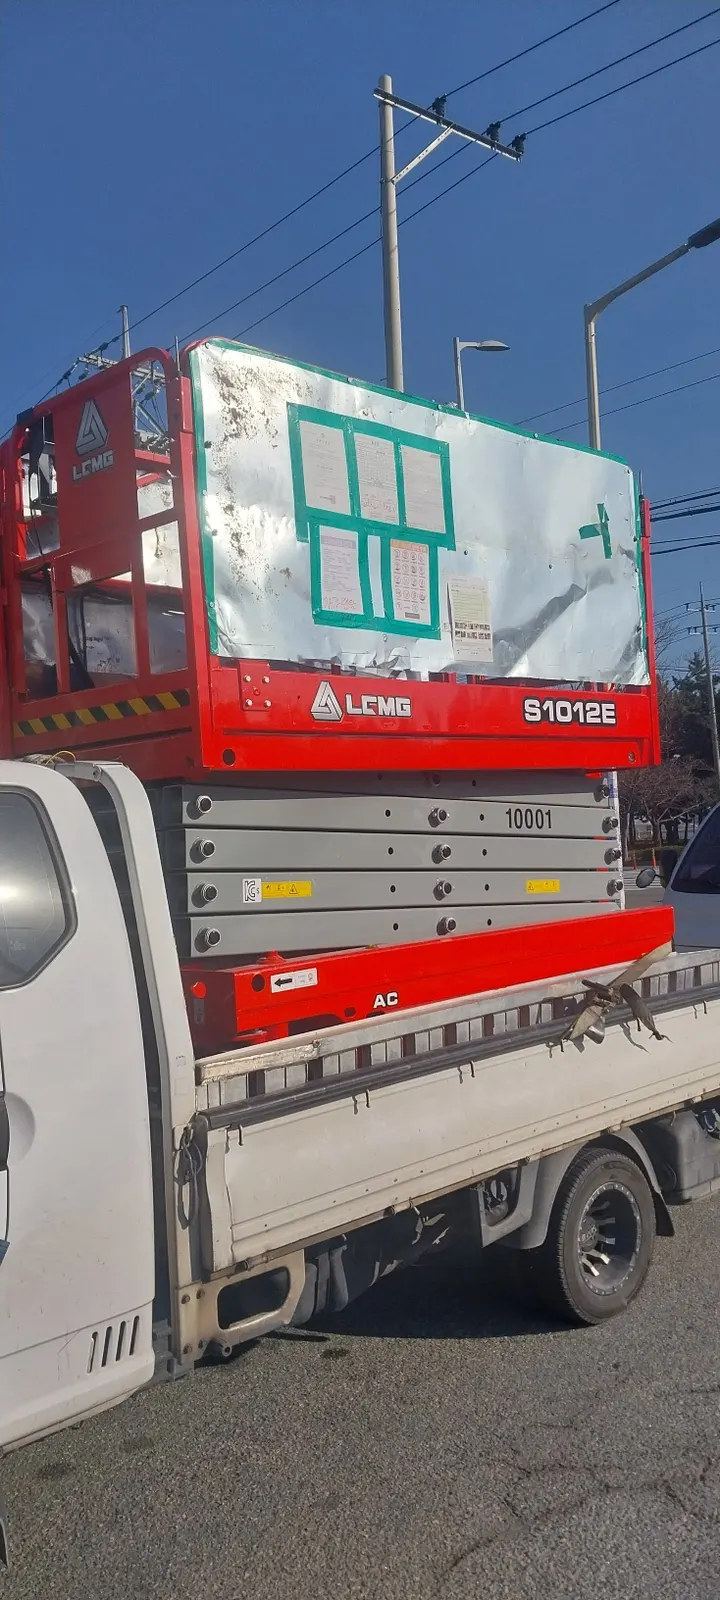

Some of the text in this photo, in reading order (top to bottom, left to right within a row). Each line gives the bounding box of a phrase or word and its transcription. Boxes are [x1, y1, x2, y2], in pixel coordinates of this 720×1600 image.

[523, 698, 617, 725] S1012E
[505, 808, 552, 829] 10001
[373, 991, 399, 1009] AC
